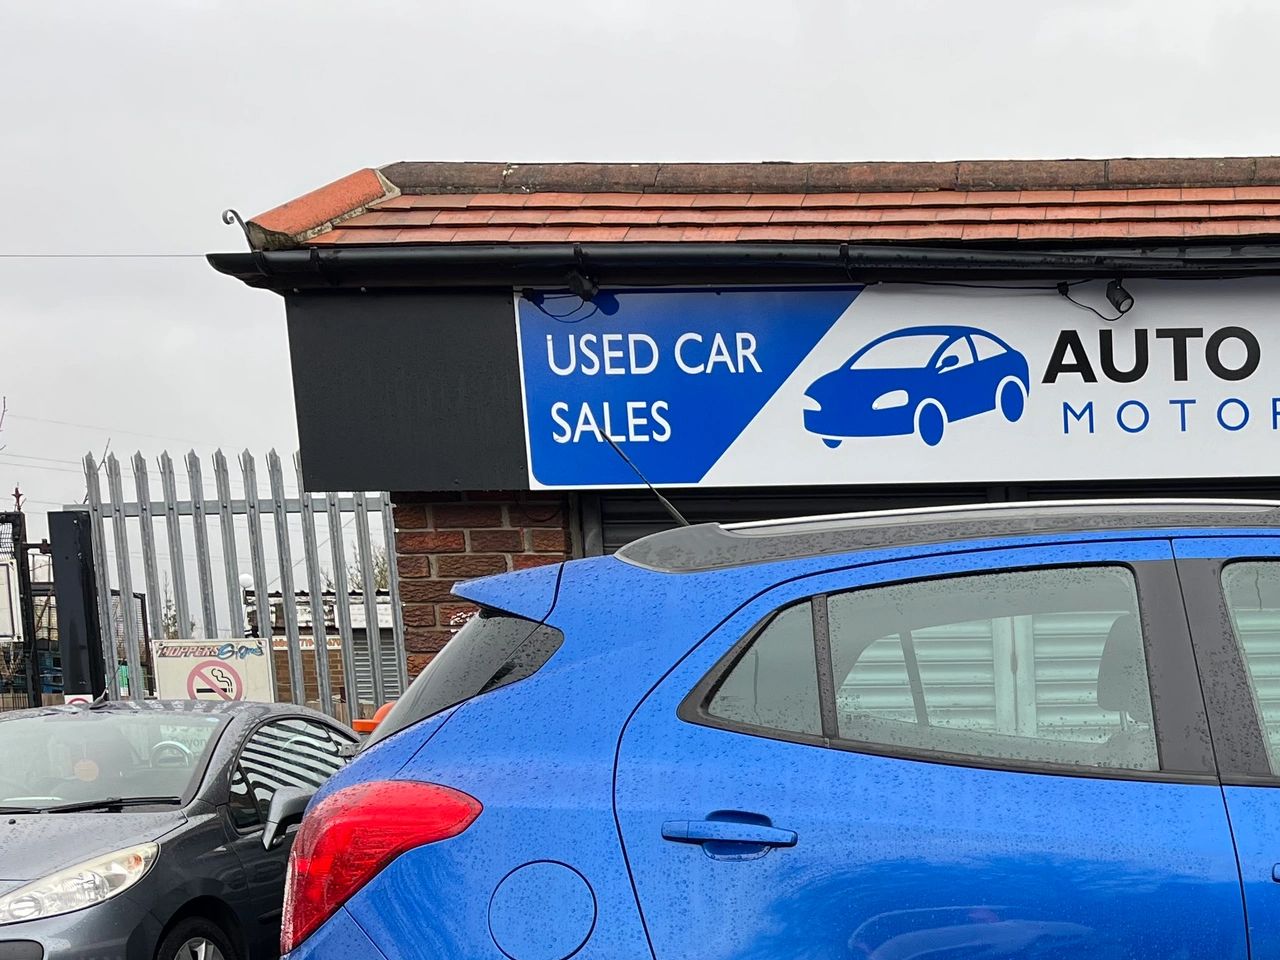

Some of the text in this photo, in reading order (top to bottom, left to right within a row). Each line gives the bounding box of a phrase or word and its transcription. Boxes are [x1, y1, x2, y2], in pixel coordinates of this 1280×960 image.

[547, 333, 762, 375] USED CAR
[1042, 326, 1260, 383] AUTO
[552, 401, 671, 443] SALES
